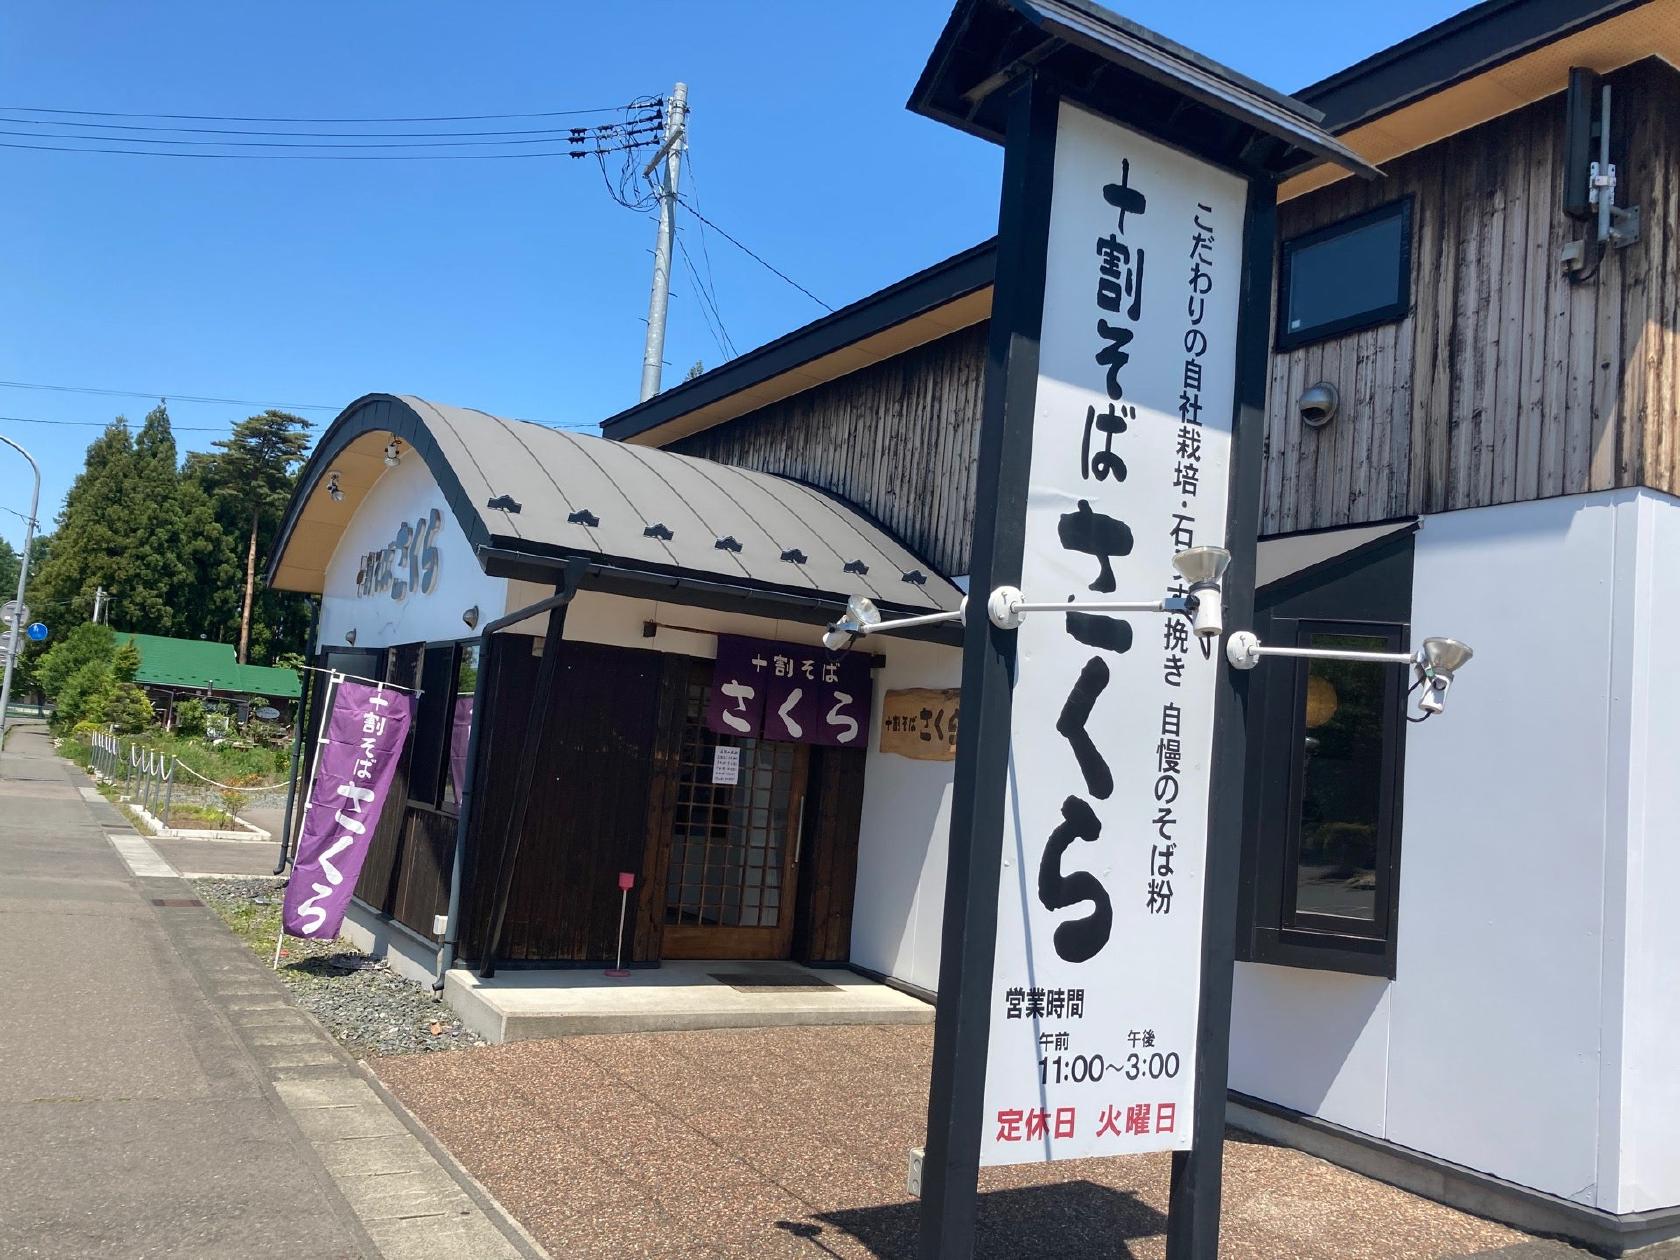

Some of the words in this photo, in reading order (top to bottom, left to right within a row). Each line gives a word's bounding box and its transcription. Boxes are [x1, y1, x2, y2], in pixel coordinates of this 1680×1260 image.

[1081, 158, 1147, 482] 十割そば
[1164, 203, 1213, 687] こだわりの自社栽培・石挽き
[752, 654, 840, 683] 十割そば
[353, 693, 388, 779] 十割そば
[721, 679, 859, 743] さくら
[1146, 702, 1182, 914] 自慢のそば粉
[297, 781, 375, 934] さくら
[1005, 988, 1085, 1019] 営業時間
[1039, 1031, 1070, 1051] 午前
[1127, 1029, 1155, 1049] 午後
[996, 1107, 1075, 1143] 定休日
[1096, 1102, 1176, 1138] 火曜日
